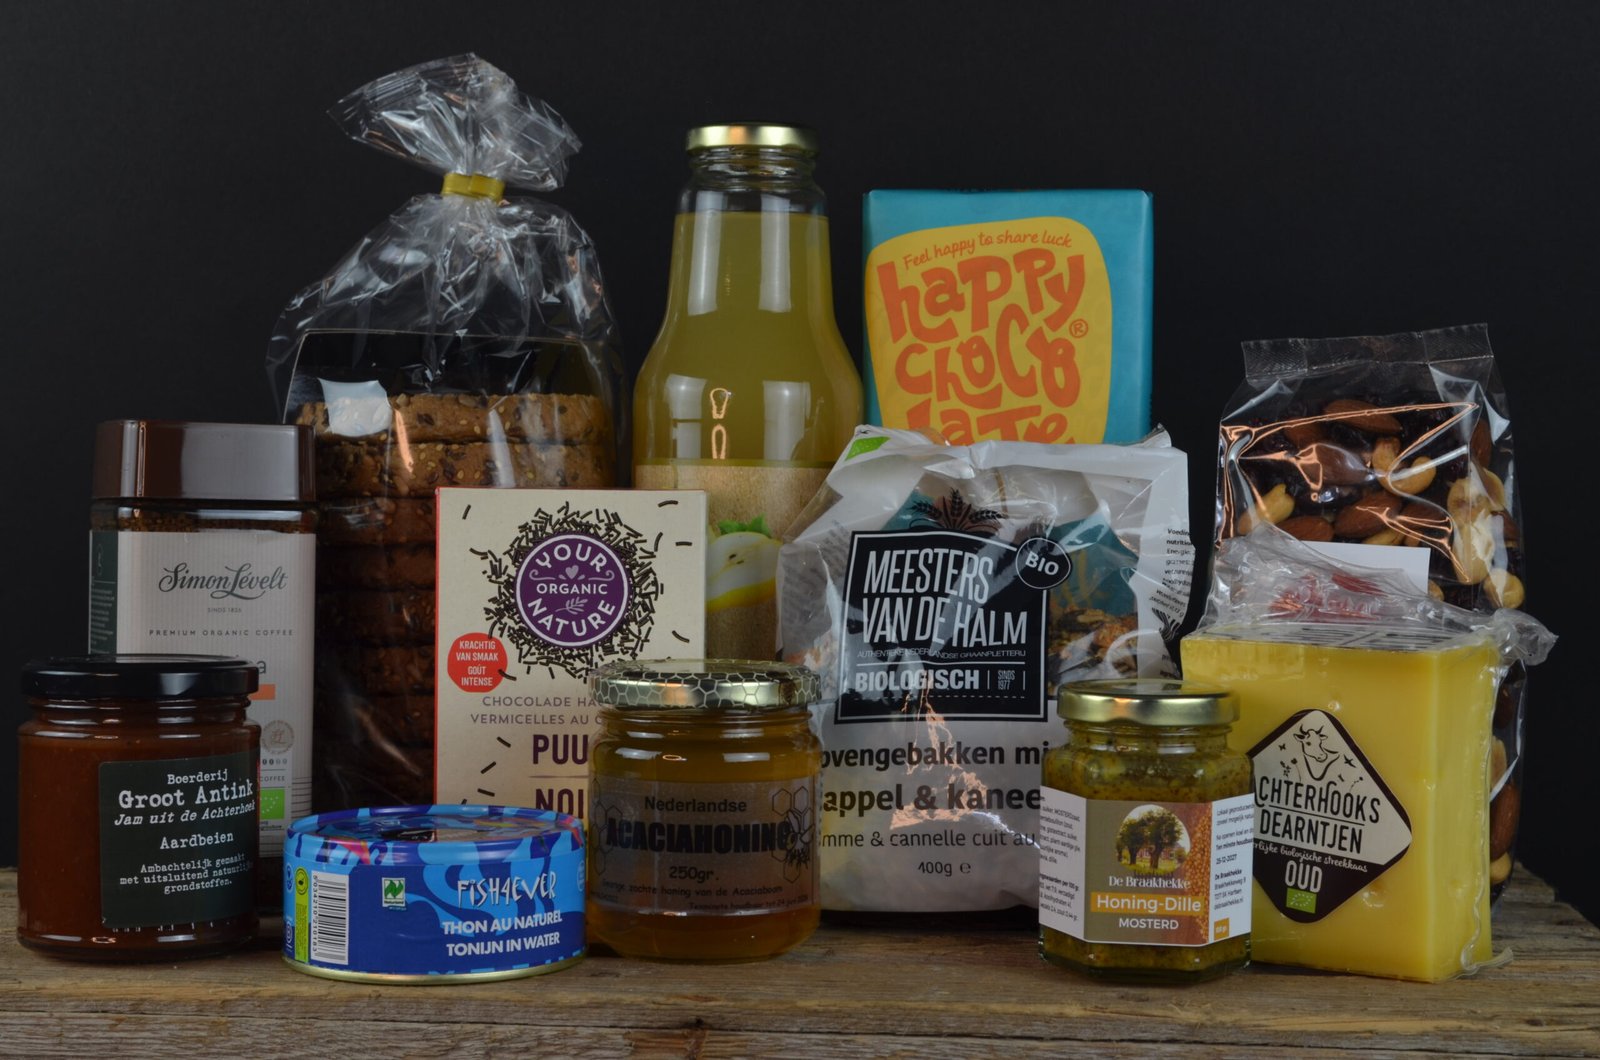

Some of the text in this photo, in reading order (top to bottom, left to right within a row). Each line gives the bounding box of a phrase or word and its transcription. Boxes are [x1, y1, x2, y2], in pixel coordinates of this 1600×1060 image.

[904, 230, 1072, 270] Feel happy to share luck
[535, 543, 608, 573] YOUR
[1025, 551, 1059, 576] BIO
[863, 548, 994, 603] MEESTERS
[536, 583, 609, 595] ORGANIC
[527, 598, 617, 637] NATURE
[862, 596, 1028, 648] VAN DE HALM
[459, 640, 496, 650] KRACHTIG
[455, 652, 499, 662] VAN SMAAK
[461, 677, 493, 687] INTENSE
[855, 669, 980, 692] BIOLOGISCH
[997, 680, 1011, 691] 1977
[482, 696, 571, 707] CHOCOLADE
[470, 713, 565, 725] VERMICELLES
[570, 713, 589, 725] AU
[166, 769, 228, 785] Boerderij
[118, 778, 254, 809] Groot Antink
[823, 784, 903, 817] appel
[914, 785, 937, 810] &
[1255, 776, 1381, 824] CHTERHOOKS
[645, 797, 747, 813] Nederlandse
[114, 813, 144, 826] Jam
[149, 811, 175, 824] uit
[180, 809, 198, 821] de
[870, 831, 884, 846] &
[890, 830, 967, 846] cannelle
[973, 832, 1006, 846] cuit
[1012, 832, 1036, 846] au
[1259, 809, 1363, 854] DEARNTJEN
[160, 831, 234, 850] Aardbeien
[140, 859, 213, 874] Ambachtelijk
[1280, 845, 1323, 864] biologische
[1323, 854, 1369, 873] streekkaas
[119, 874, 140, 885] met
[143, 869, 209, 884] uitsluitend
[669, 866, 720, 884] 250gr.
[918, 861, 953, 877] 100g
[1284, 859, 1323, 893] OUD
[164, 878, 233, 894] grondstoffen.
[716, 887, 728, 896] de
[1108, 876, 1191, 890] De Braakhekke
[1097, 895, 1201, 913] Honing-Dille
[442, 909, 563, 936] THON AU NATUREL
[1118, 918, 1179, 930] MOSTERD
[446, 932, 561, 957] TONIJN IN WATER
